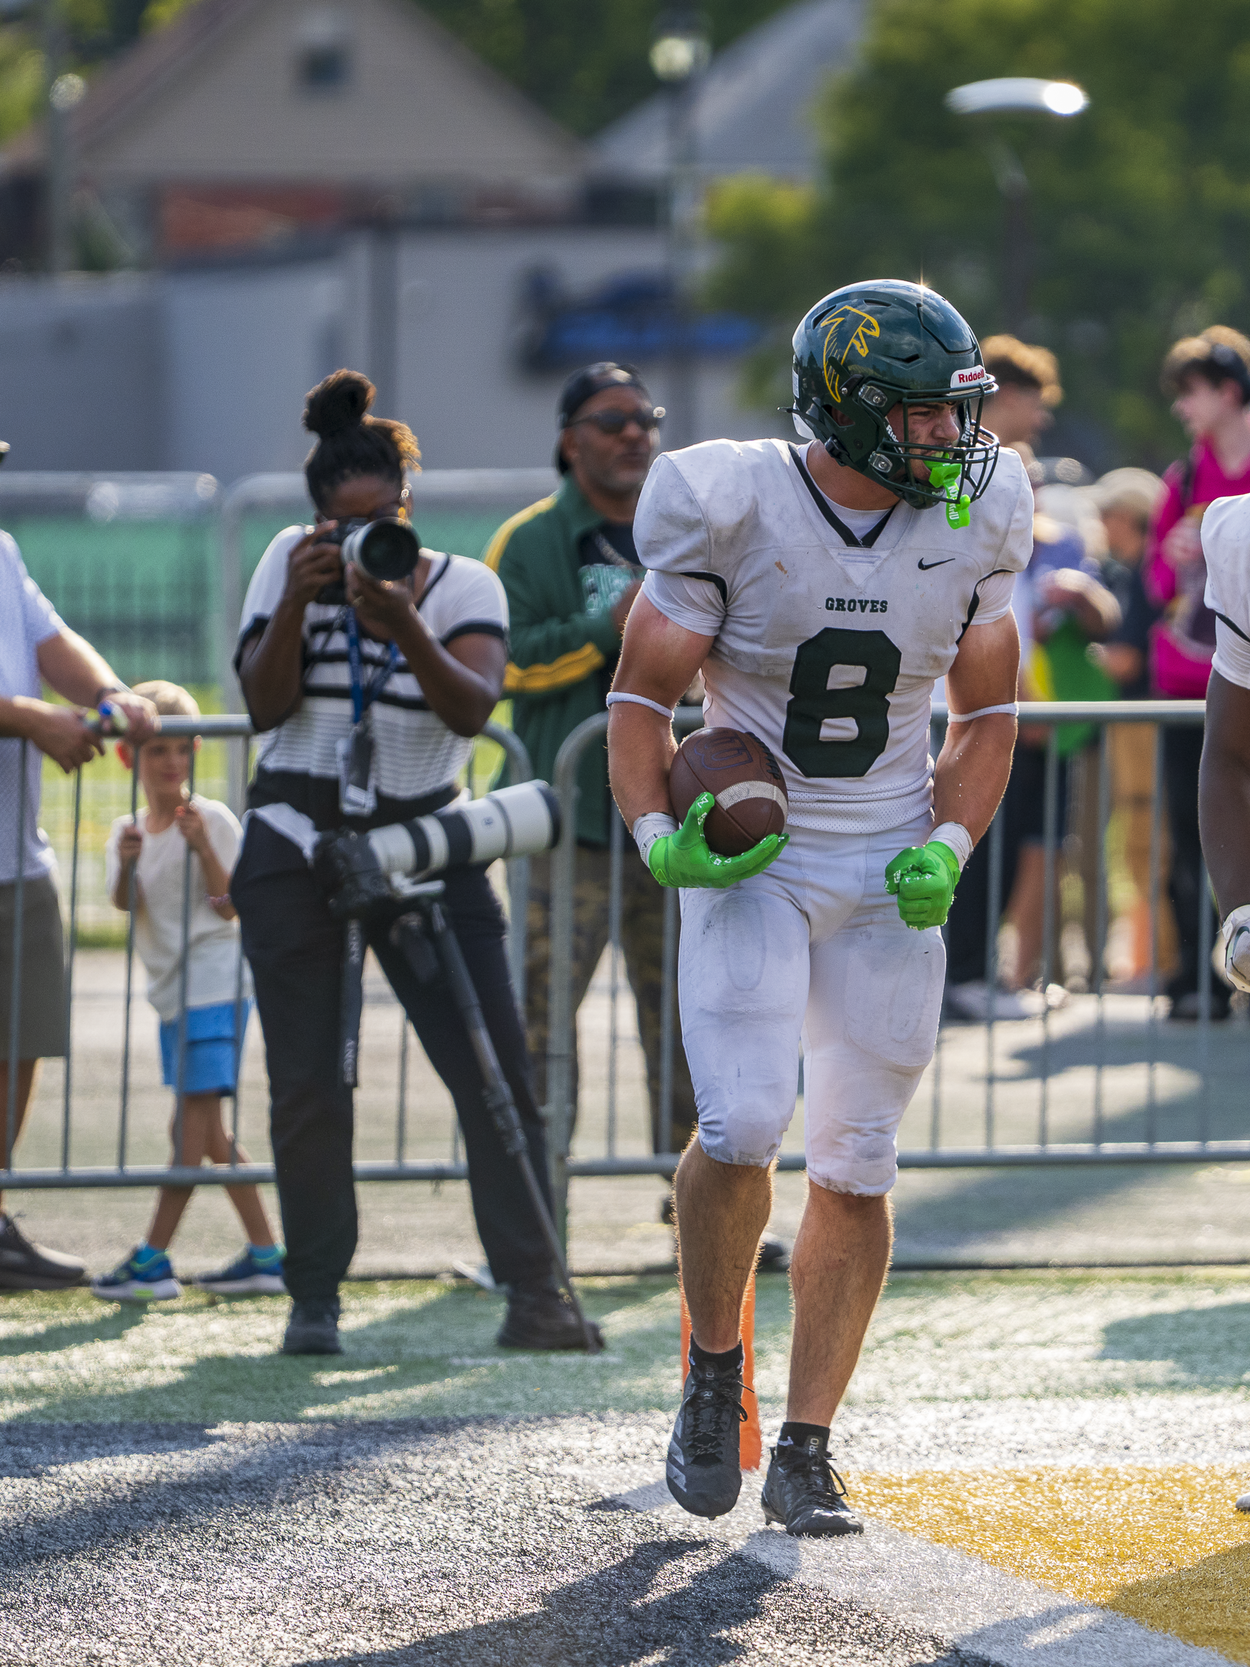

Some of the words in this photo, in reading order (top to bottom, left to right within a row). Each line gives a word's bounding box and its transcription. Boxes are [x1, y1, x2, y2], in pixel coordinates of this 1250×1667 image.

[958, 368, 985, 384] Riddell
[825, 597, 888, 613] GROVES
[782, 626, 902, 778] 8
